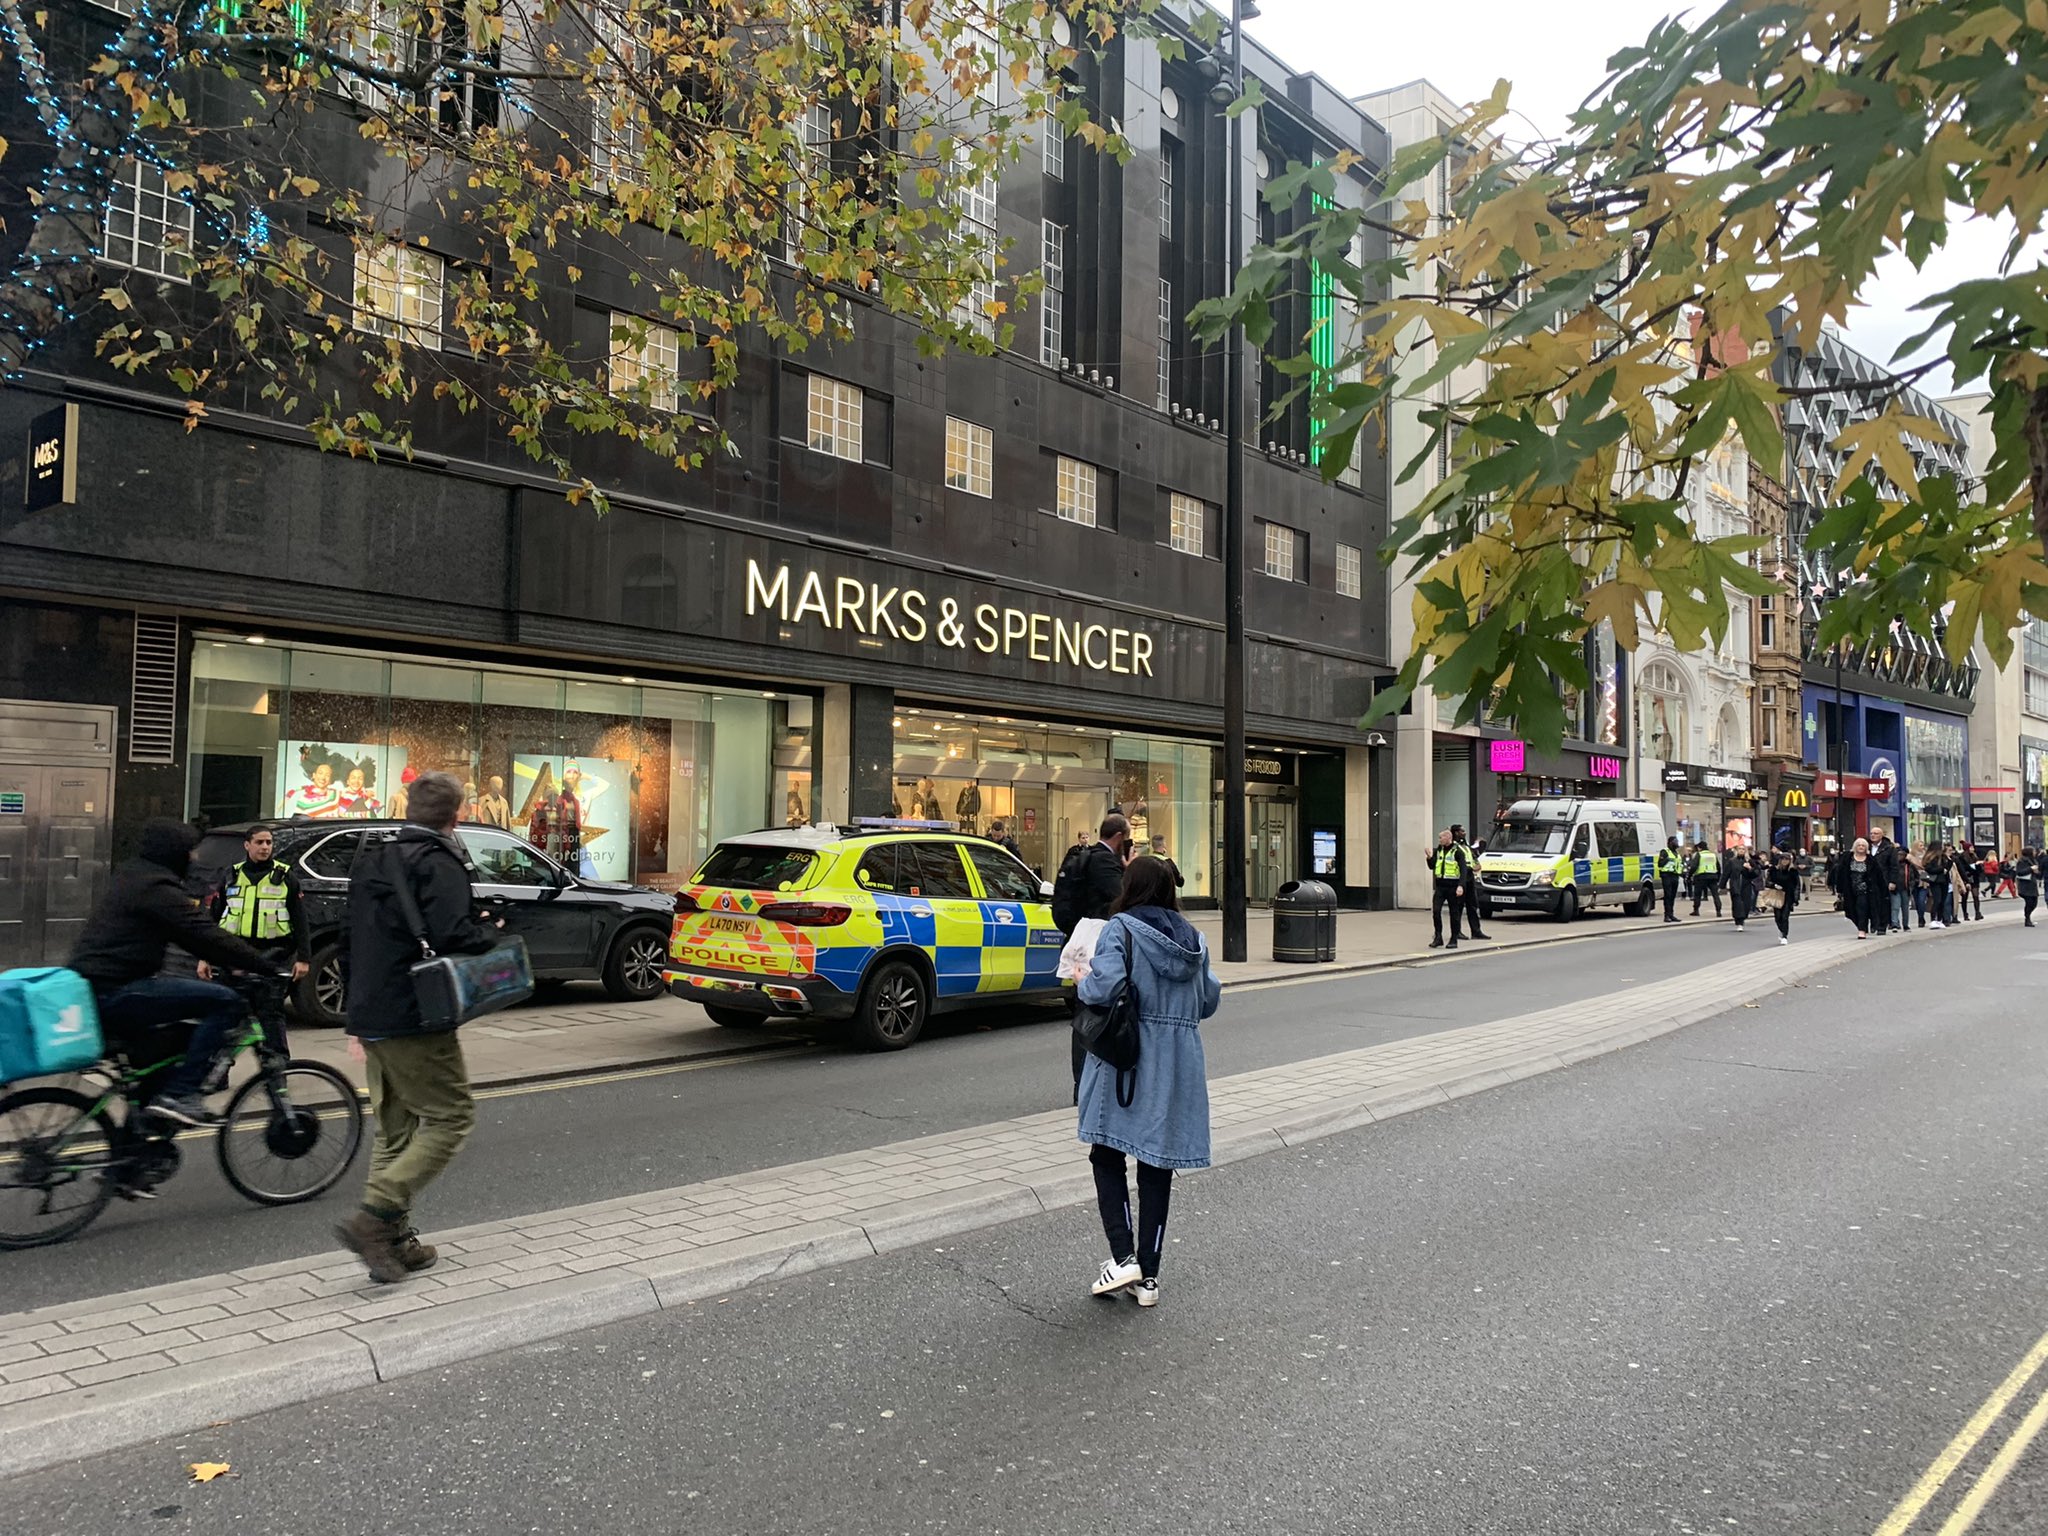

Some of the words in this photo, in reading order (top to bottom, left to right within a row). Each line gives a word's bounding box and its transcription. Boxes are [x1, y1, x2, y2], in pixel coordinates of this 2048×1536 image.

[34, 438, 59, 468] M&S
[745, 559, 927, 642] MARKS
[937, 597, 966, 649] &
[973, 603, 1153, 677] SPENCER
[1494, 743, 1520, 752] LUSH
[1590, 756, 1620, 779] LUSH
[2025, 798, 2042, 810] JD
[1611, 810, 1640, 820] POLICE
[552, 847, 616, 865] ordinary
[786, 852, 812, 864] ERG
[843, 895, 866, 904] ERG
[710, 917, 732, 931] LA70
[733, 919, 751, 932] NSV
[682, 946, 779, 968] POLICE
